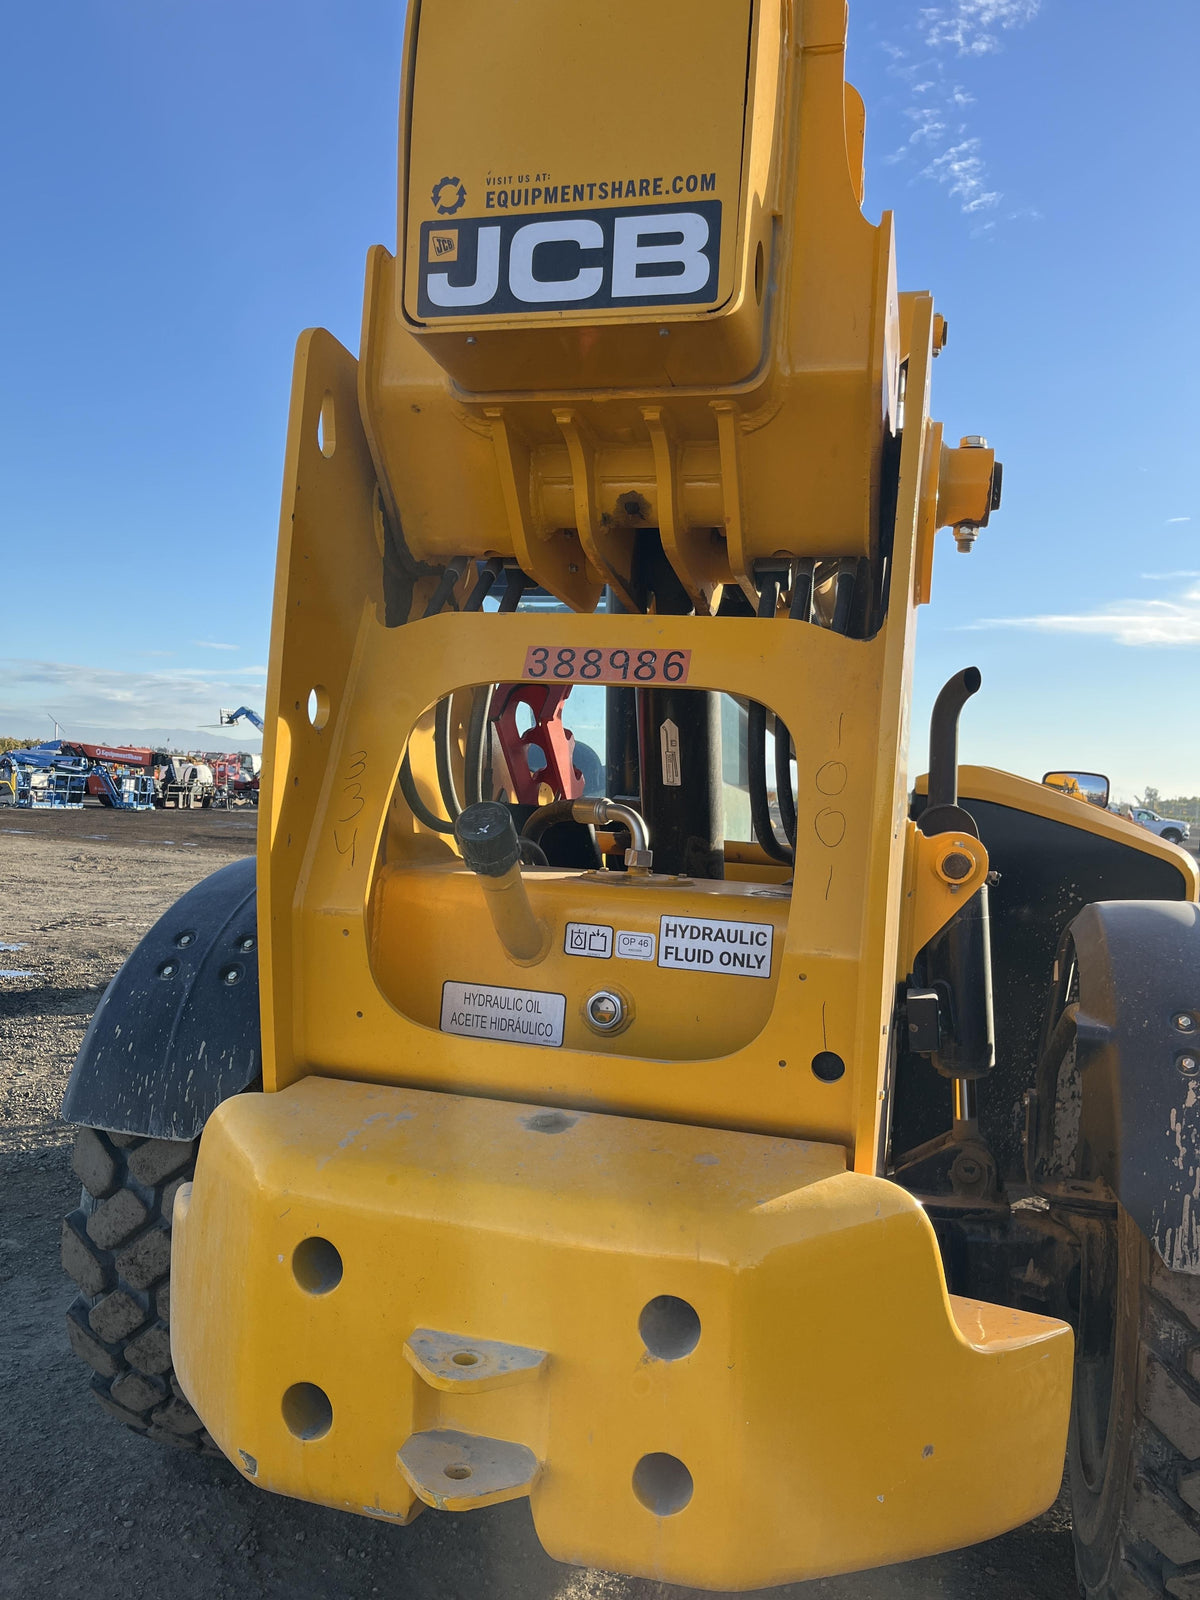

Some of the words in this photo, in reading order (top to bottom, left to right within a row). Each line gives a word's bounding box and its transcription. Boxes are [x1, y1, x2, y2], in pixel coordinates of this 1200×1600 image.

[485, 173, 717, 209] EQUIPMENTSHARE.COM
[486, 175, 514, 186] VISIT
[517, 175, 531, 184] US
[535, 173, 551, 182] AT:
[435, 236, 455, 255] JCB
[427, 212, 710, 308] JCB
[528, 647, 685, 682] 388986
[622, 936, 636, 946] OP
[638, 939, 649, 948] 46
[664, 923, 768, 947] HYDRAULIC
[663, 945, 715, 965] FLUID
[719, 950, 766, 970] ONLY
[463, 991, 524, 1012] HYDRAULIC
[526, 998, 543, 1015] OIL
[450, 1013, 488, 1030] ACEITE
[489, 1016, 553, 1038] HIDRÁULICO
